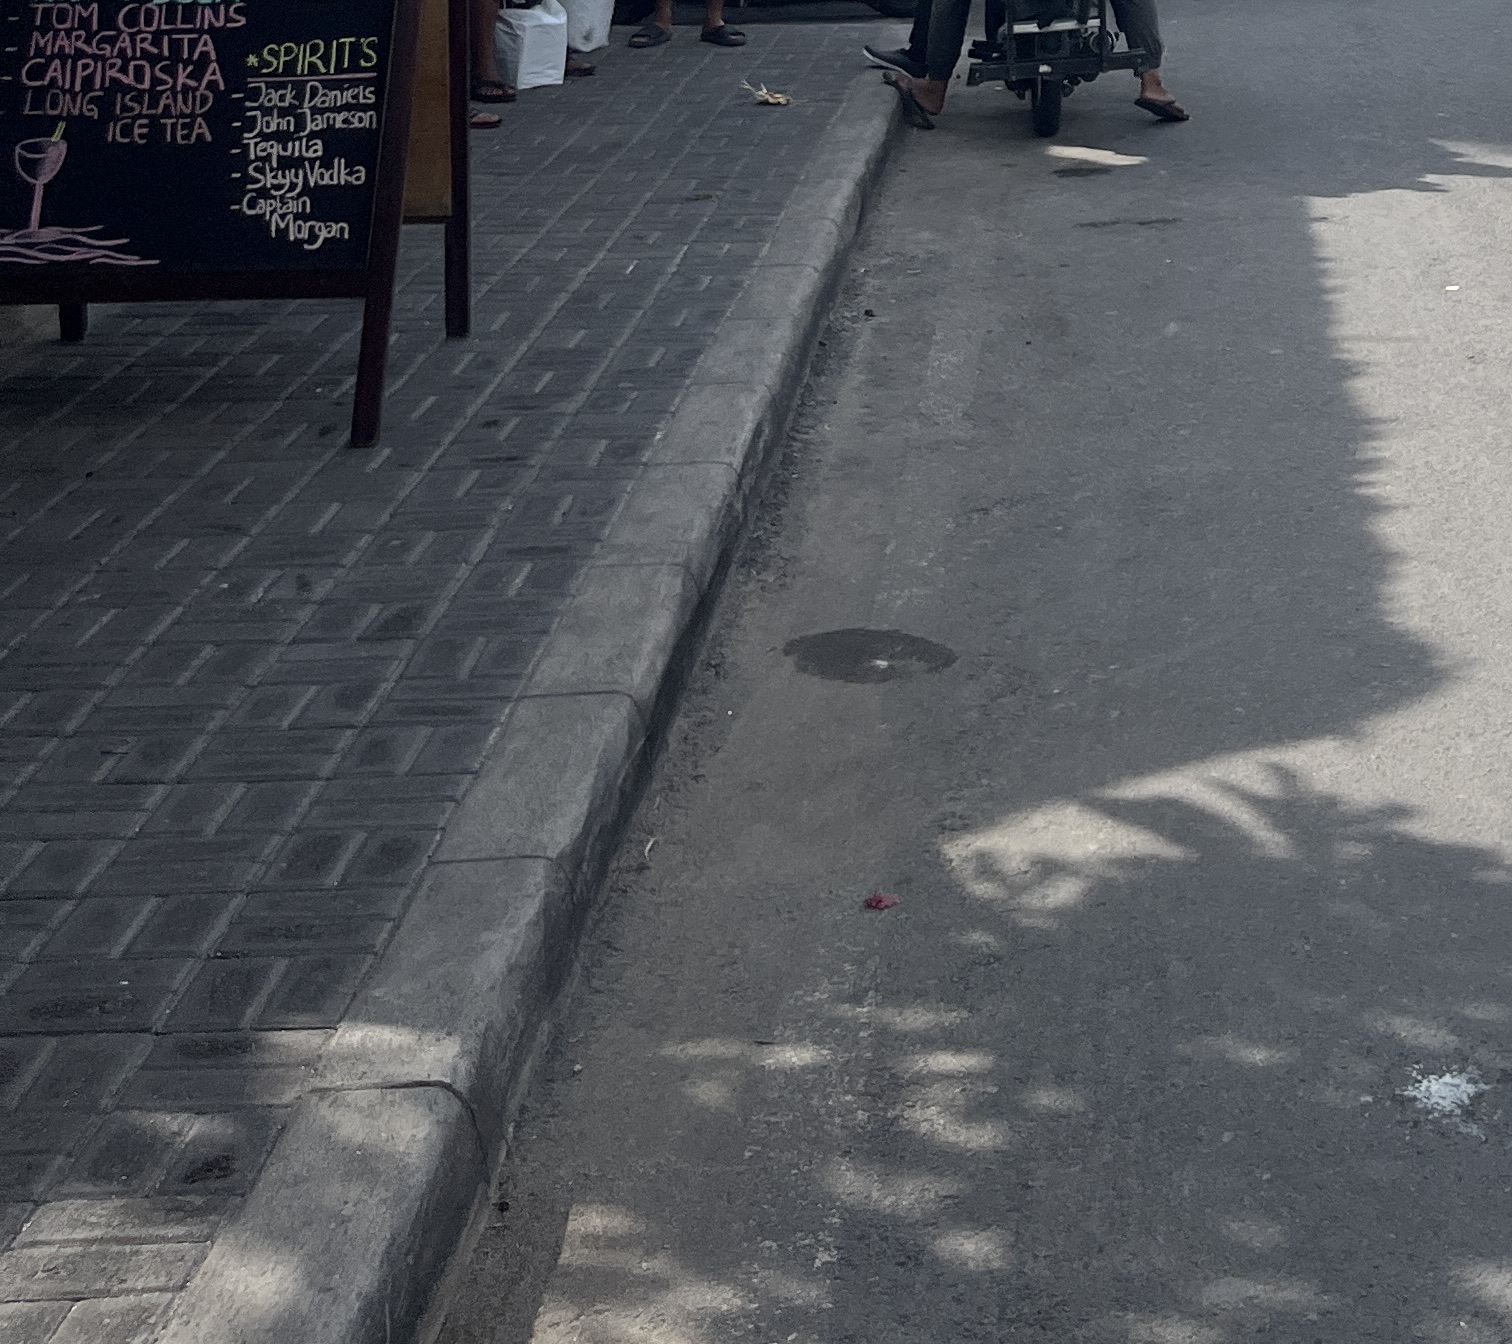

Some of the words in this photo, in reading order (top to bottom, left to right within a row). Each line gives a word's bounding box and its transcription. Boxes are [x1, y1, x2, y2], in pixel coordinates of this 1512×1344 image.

[29, 2, 99, 31] TOM
[117, 2, 247, 33] COLLINS
[29, 30, 218, 61] MARGARITA
[261, 37, 378, 75] SPIRIT'S
[21, 58, 226, 92] CAIPIROSKA
[23, 89, 105, 120] LONG
[115, 90, 214, 118] ISLAND
[245, 82, 300, 107] Jack
[107, 119, 150, 144] ICE
[160, 117, 213, 144] TEA
[243, 108, 295, 137] John
[294, 109, 377, 137] Jameson
[242, 192, 311, 221] Captain
[272, 213, 350, 250] Morgan
